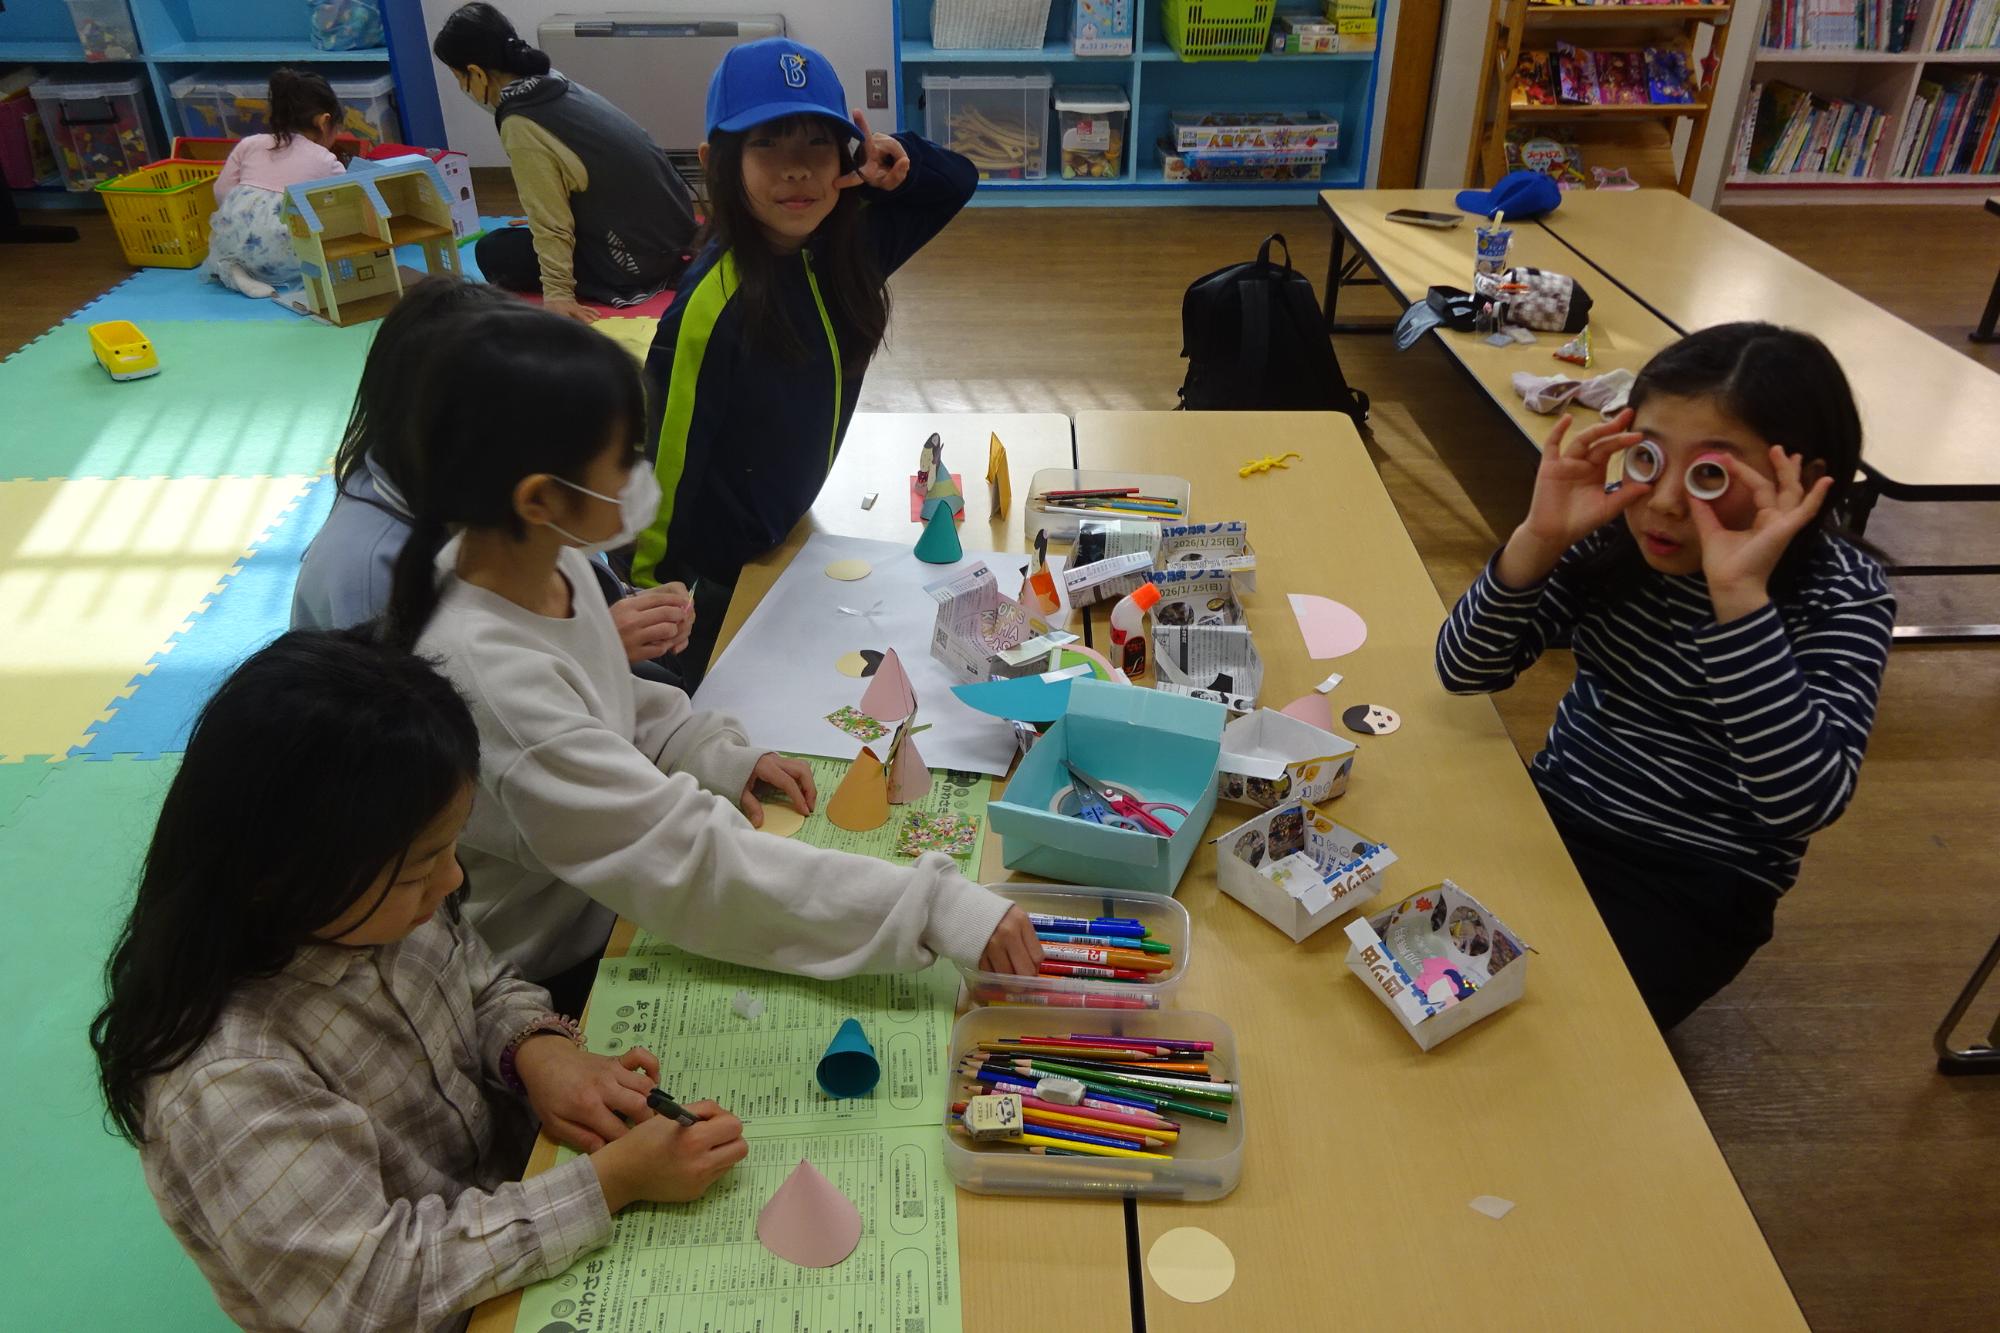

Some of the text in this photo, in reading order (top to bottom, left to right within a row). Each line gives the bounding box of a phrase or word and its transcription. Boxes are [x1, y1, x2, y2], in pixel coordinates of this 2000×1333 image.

[632, 1000, 650, 1033] きっず
[576, 1260, 604, 1325] かわさき
